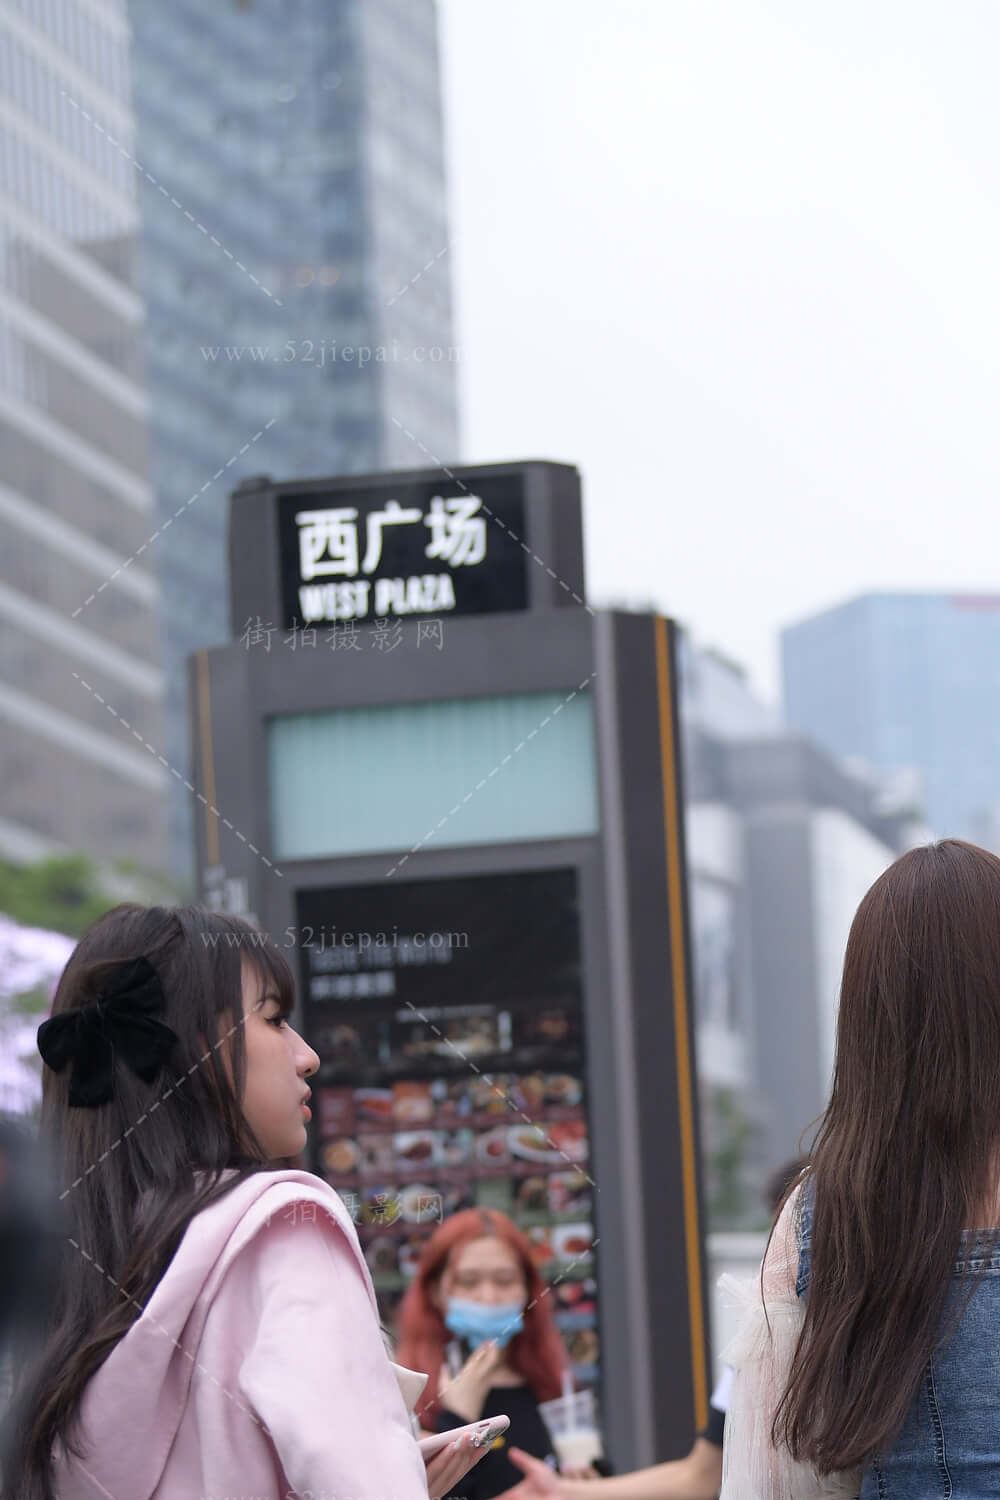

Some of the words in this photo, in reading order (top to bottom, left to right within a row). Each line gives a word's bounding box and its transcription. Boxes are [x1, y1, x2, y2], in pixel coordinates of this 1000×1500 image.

[295, 495, 487, 581] 西广场
[298, 580, 371, 622] WEST
[374, 573, 456, 616] PLAZA
